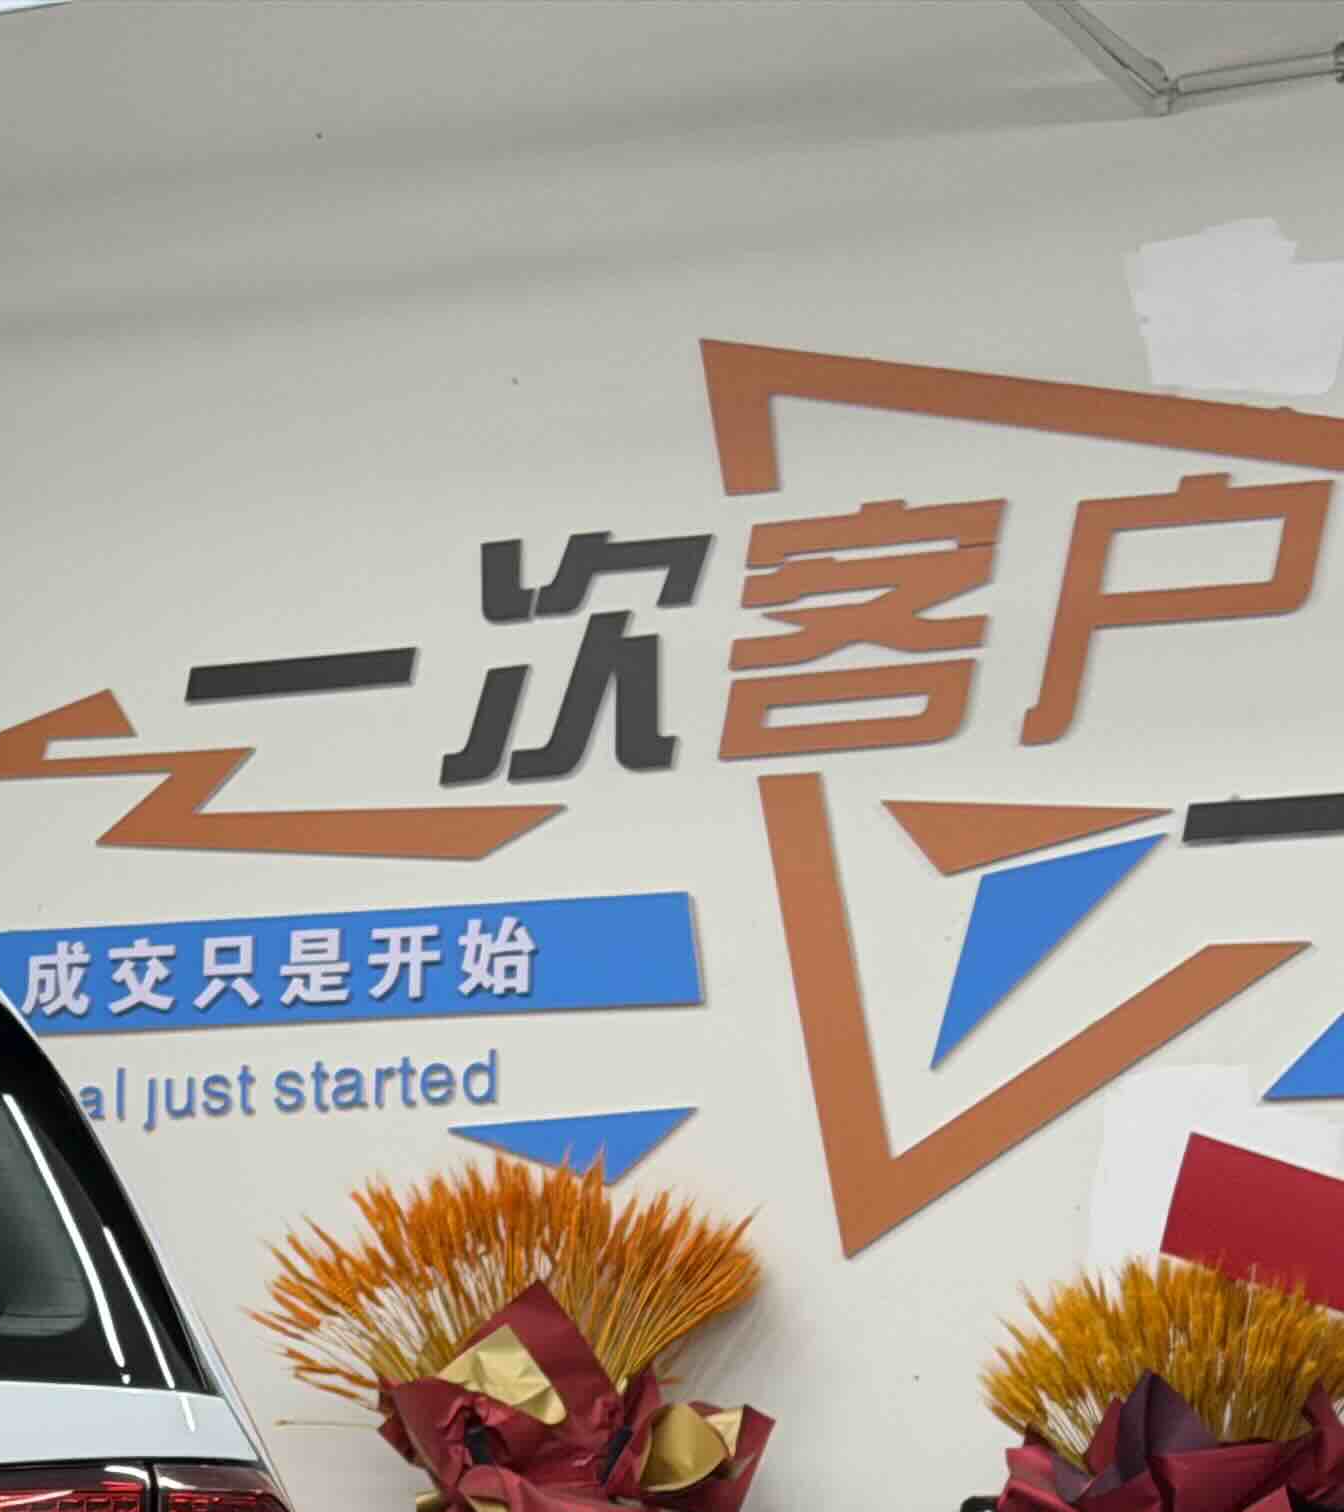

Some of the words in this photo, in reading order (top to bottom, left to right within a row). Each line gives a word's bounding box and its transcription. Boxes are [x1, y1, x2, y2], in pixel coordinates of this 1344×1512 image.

[20, 916, 537, 1018] 成交只是开始
[142, 1064, 257, 1133] just
[272, 1048, 499, 1114] started
